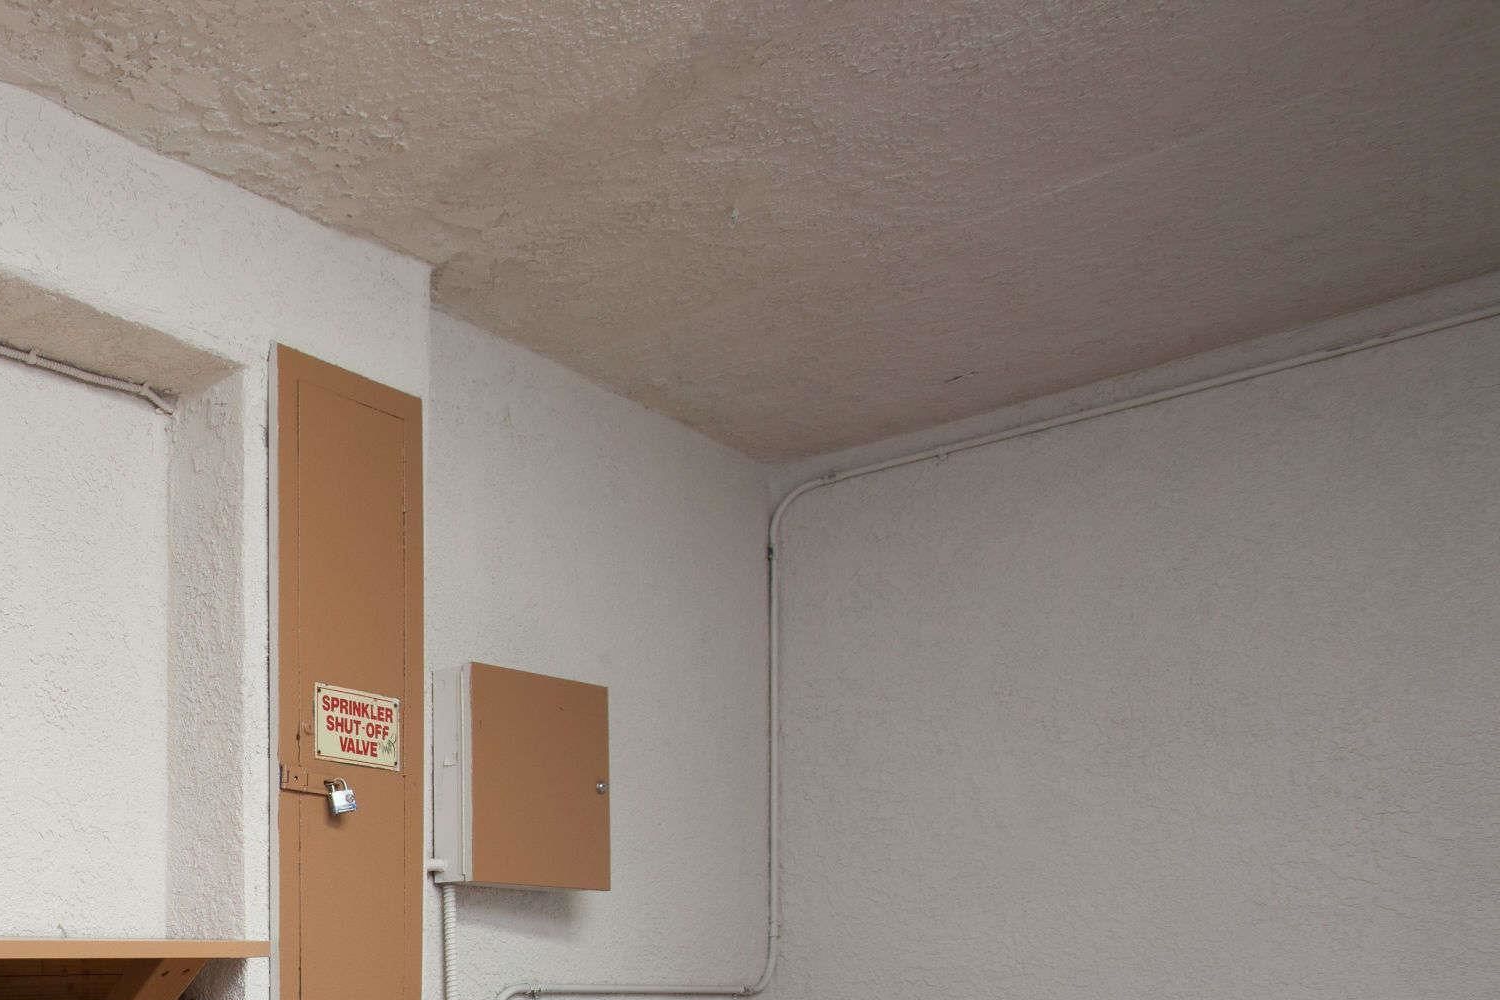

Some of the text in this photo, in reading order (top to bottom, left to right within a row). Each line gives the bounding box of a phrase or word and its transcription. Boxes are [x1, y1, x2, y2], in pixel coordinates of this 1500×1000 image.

[322, 694, 393, 724] SPRINKLER
[326, 714, 389, 741] SHUT-OFF
[339, 735, 378, 758] VALVE
